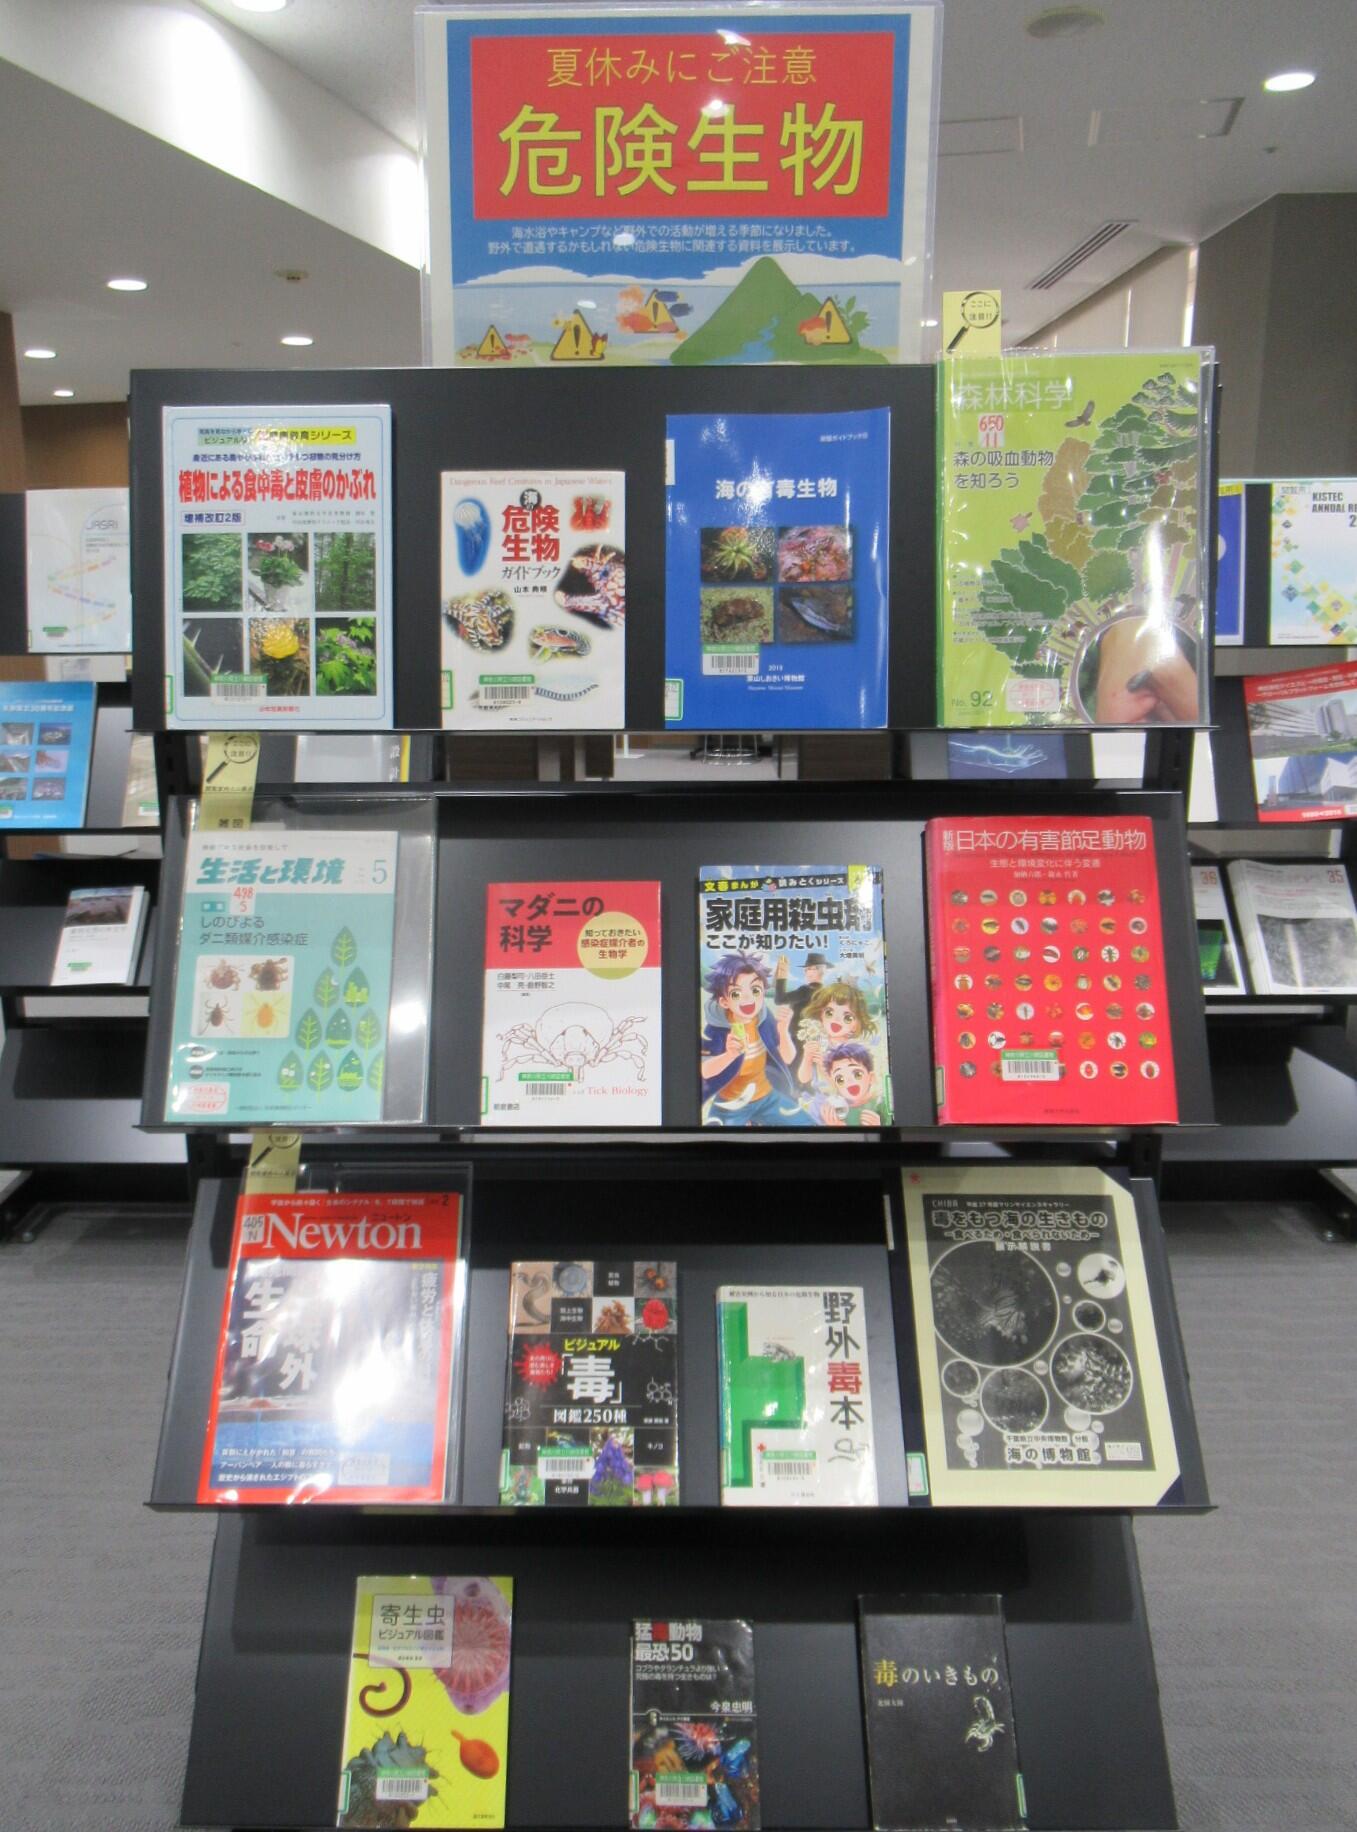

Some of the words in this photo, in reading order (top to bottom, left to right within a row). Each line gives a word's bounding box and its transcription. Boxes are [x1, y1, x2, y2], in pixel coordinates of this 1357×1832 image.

[547, 46, 818, 87] 夏休みにご注意
[499, 102, 865, 198] 危険生物
[959, 381, 1070, 411] 森林科学
[953, 450, 1056, 467] 森の吸血動物
[179, 470, 377, 503] 植物による食中毒と皮膚のかぶれ
[954, 472, 1021, 490] を知ろう
[1312, 492, 1344, 502] KISTEC
[1312, 504, 1345, 513] ANNUAL
[502, 504, 561, 534] 危険
[502, 534, 561, 562] 生物
[502, 565, 561, 580] ガイドブック
[970, 690, 994, 708] 92
[956, 829, 1147, 852] 日本の有害節足動物
[196, 857, 346, 885] 生活と環境
[371, 858, 388, 885] 5
[233, 886, 254, 899] 498
[704, 879, 760, 893] 文春まんが
[778, 876, 846, 888] 読みとくシリーズ
[499, 891, 605, 921] マダニの
[706, 897, 873, 933] 家庭用殺虫剤
[200, 915, 265, 929] しのびよる
[199, 932, 309, 946] ダニ類媒介感染症
[500, 925, 553, 953] 科学
[585, 928, 641, 937] 知っておきたい
[581, 938, 646, 948] 感染症媒介者の
[598, 949, 629, 960] 生物学
[587, 1085, 607, 1096] Tick
[612, 1085, 649, 1098] Biology
[932, 1199, 960, 1208] CHIBA
[931, 1209, 1108, 1229] 毒をもつ海の生きもの
[262, 1212, 423, 1250] Newton
[564, 1338, 622, 1352] ビジュアル
[823, 1291, 866, 1431] 野外毒本
[553, 1408, 628, 1425] 図鑑250種
[1007, 1447, 1093, 1463] 海の博物館
[380, 1603, 446, 1627] 寄生虫
[378, 1629, 445, 1642] ビジュアル図鑑
[635, 1642, 695, 1662] 最恐50
[873, 1659, 1000, 1688] 毒のいきもの
[710, 1700, 754, 1714] 今泉忠明
